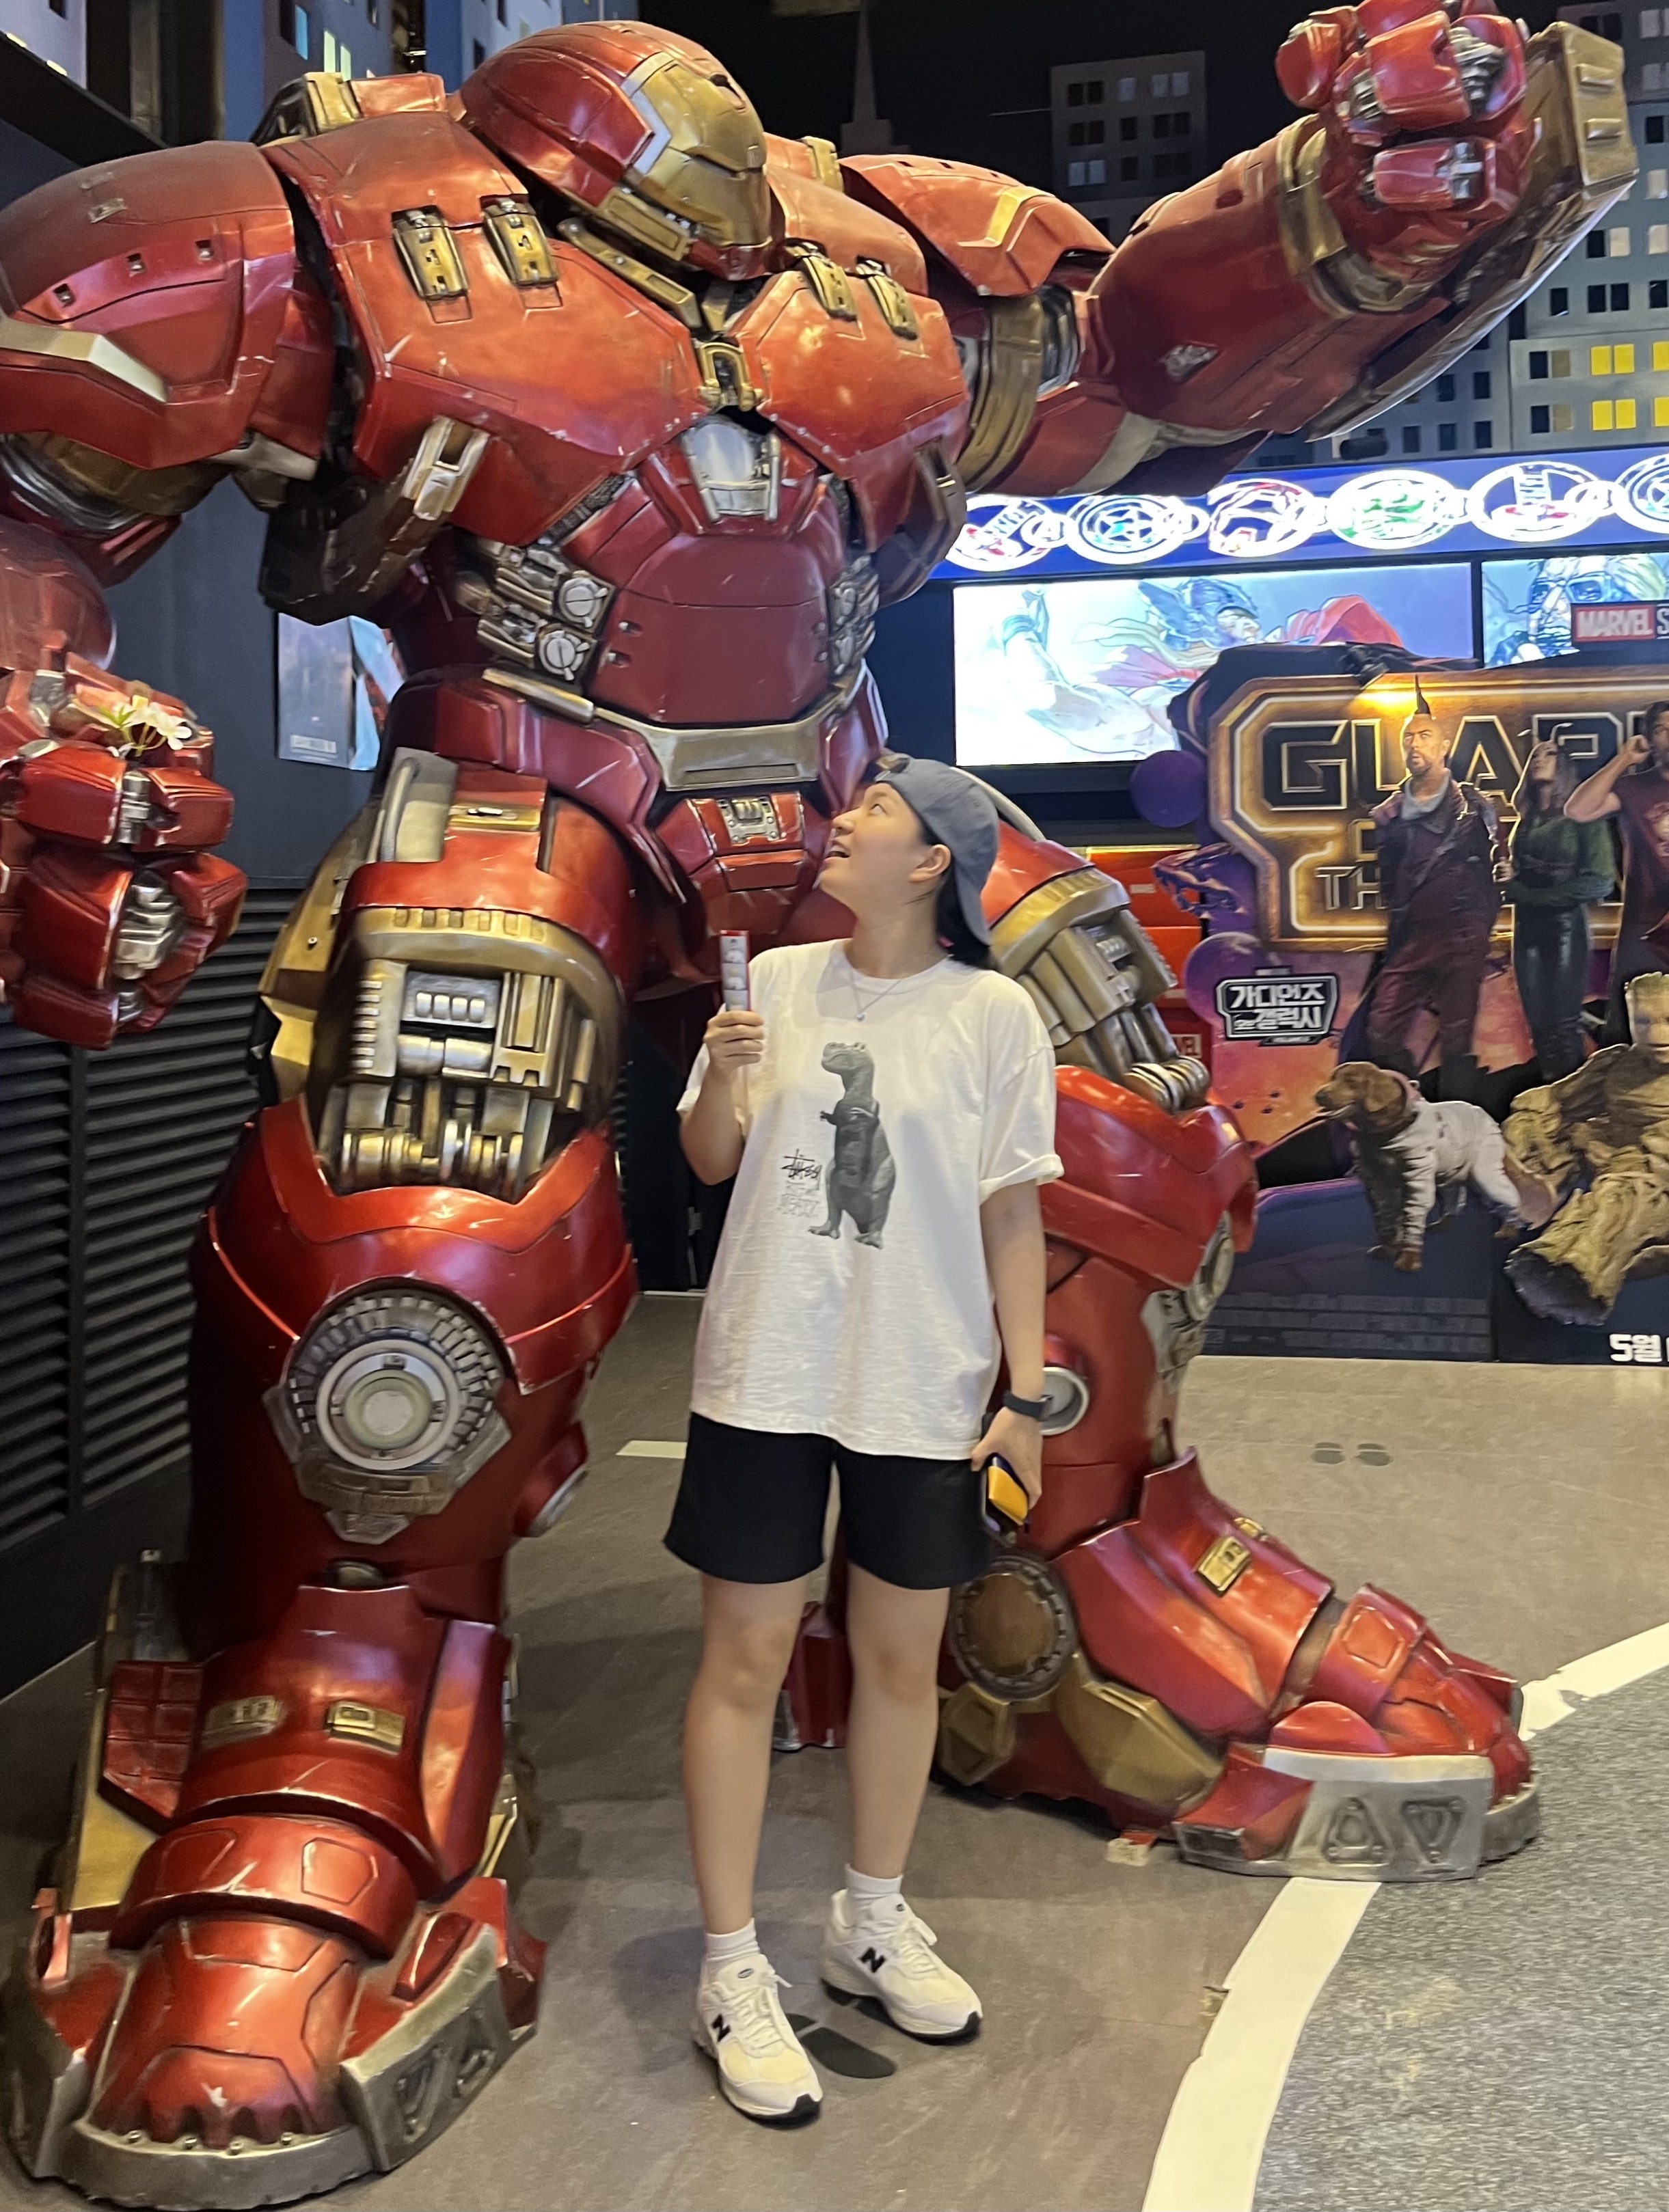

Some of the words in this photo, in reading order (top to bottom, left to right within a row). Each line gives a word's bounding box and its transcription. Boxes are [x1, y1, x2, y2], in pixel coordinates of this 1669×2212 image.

[1576, 608, 1653, 638] MARVEL
[1315, 866, 1386, 911] TH
[1230, 983, 1326, 1009] 가디언즈
[1609, 1333, 1662, 1362] 5월
